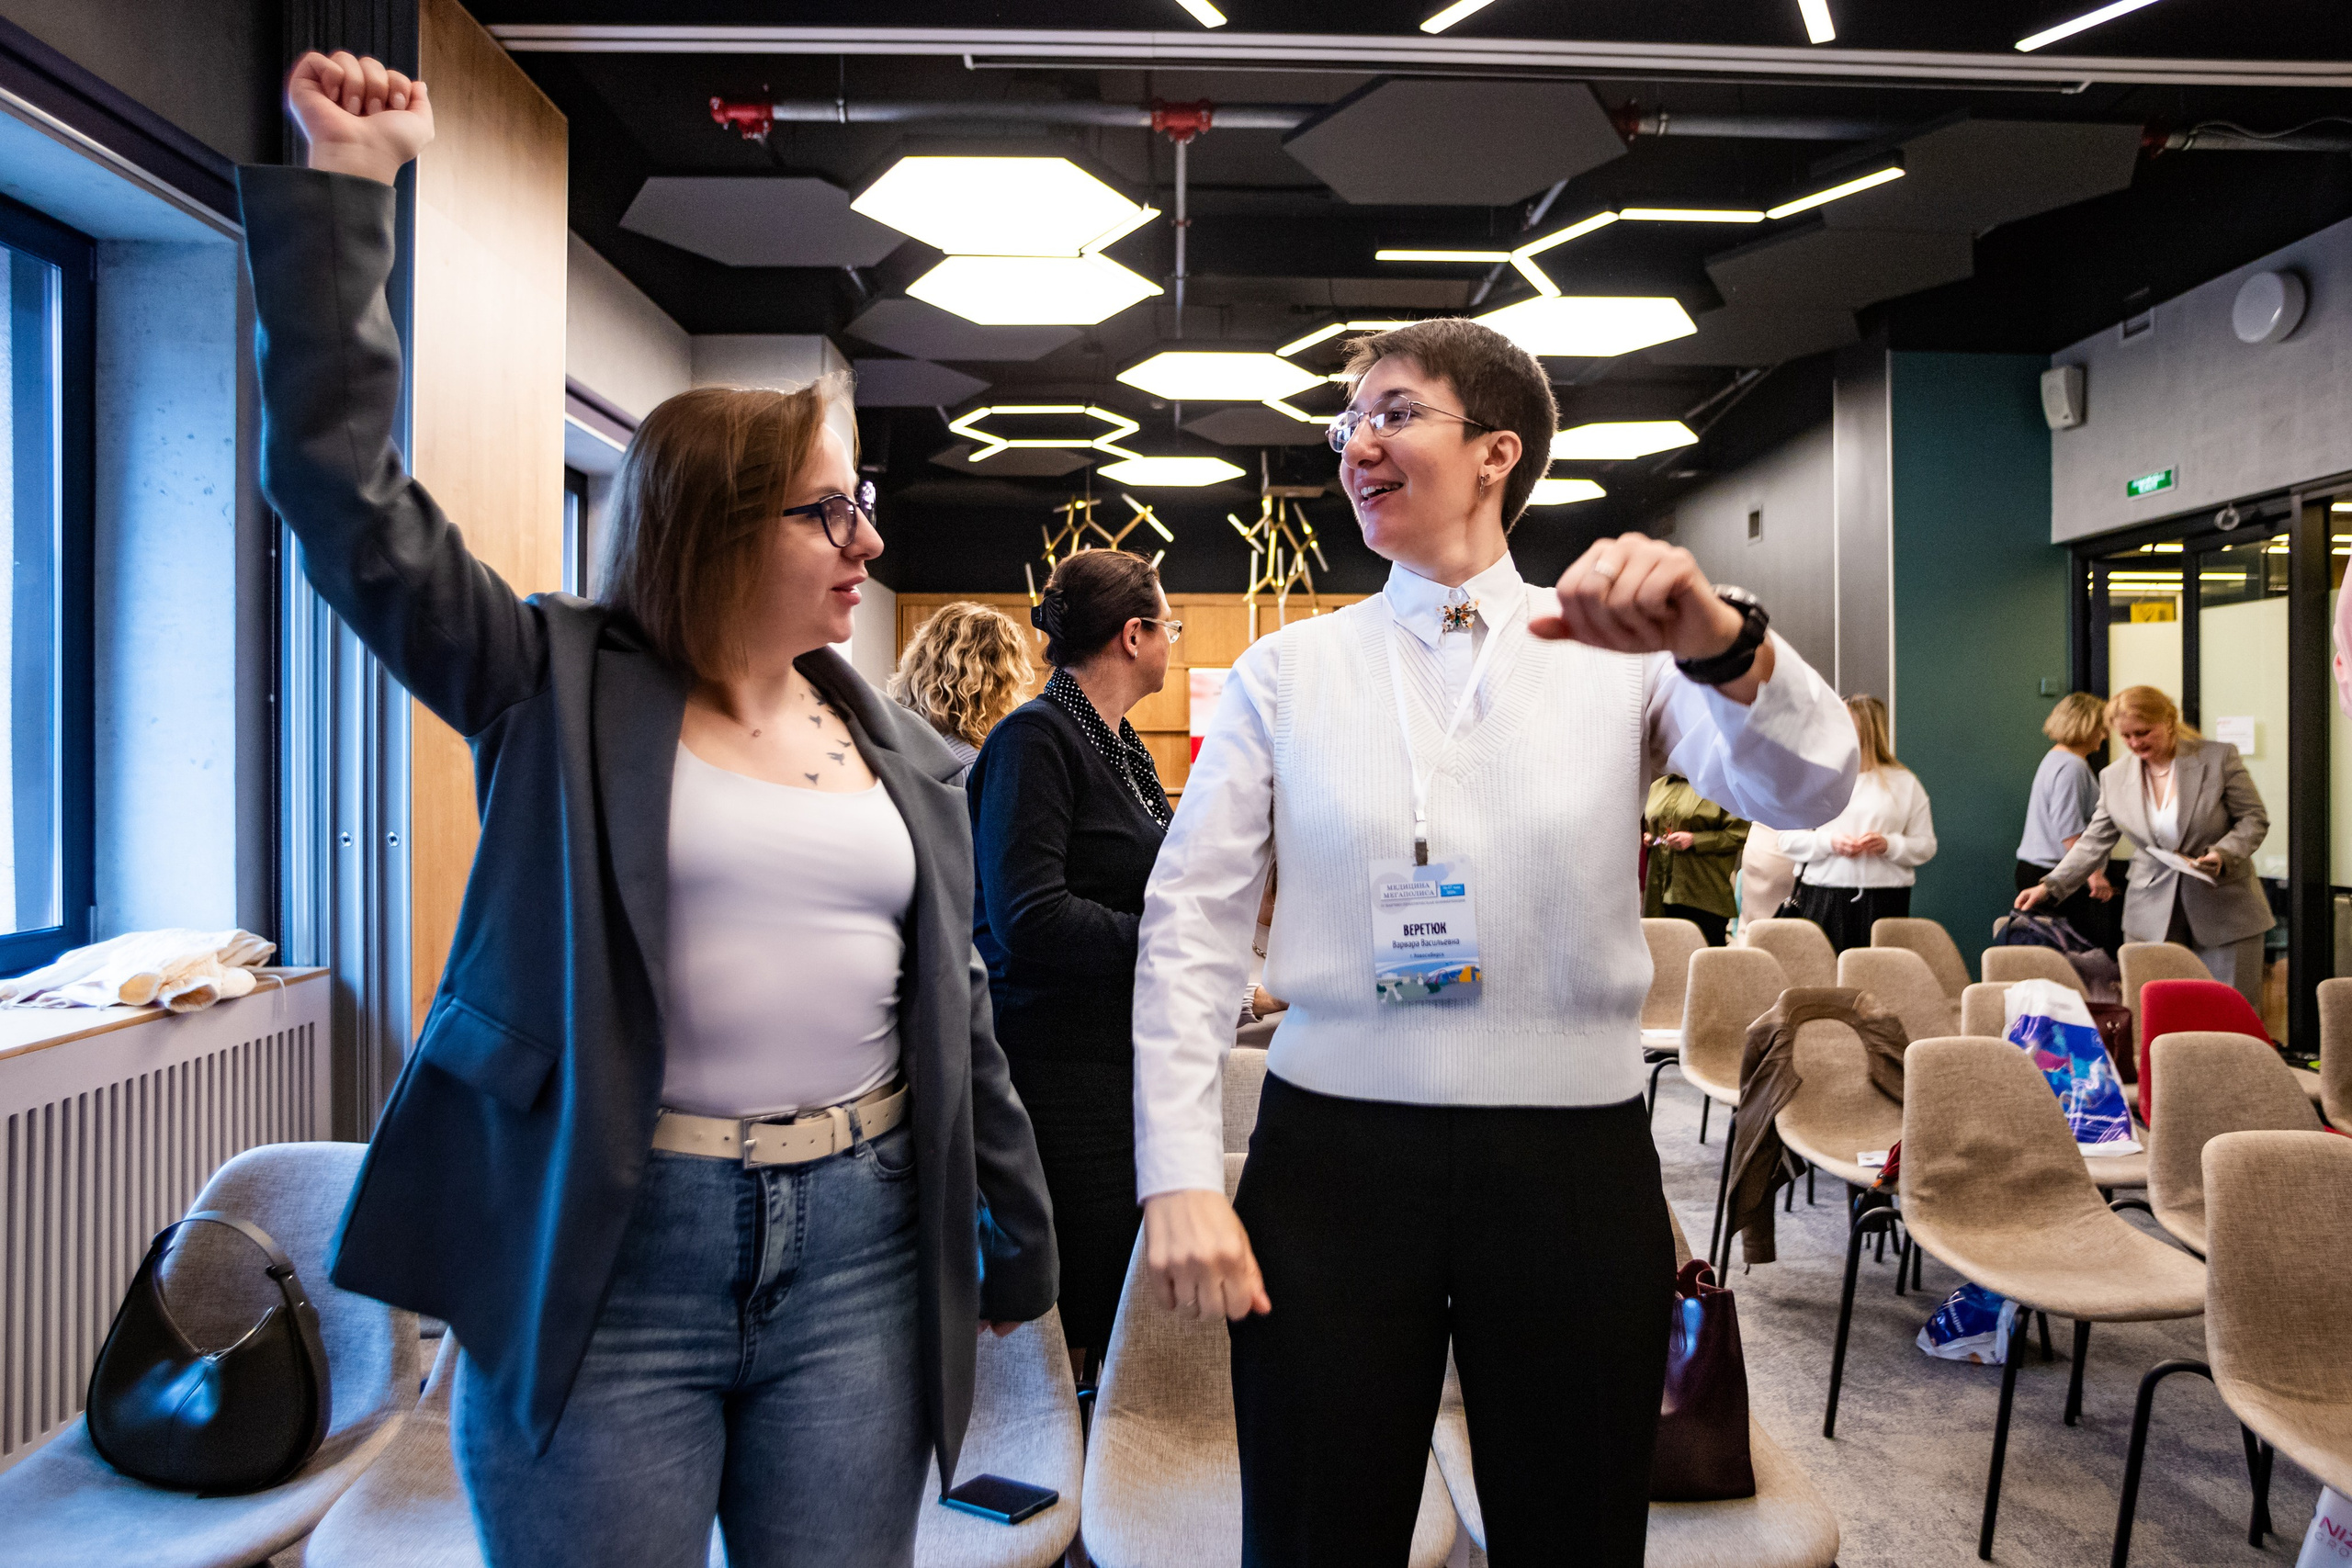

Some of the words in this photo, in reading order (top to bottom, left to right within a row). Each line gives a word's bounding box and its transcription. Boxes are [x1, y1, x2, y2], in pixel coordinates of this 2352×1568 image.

[1386, 883, 1430, 891] МЕДИЦИНА
[1383, 889, 1435, 898] МЕГАПОЛИСА
[1403, 921, 1447, 936] ВЕРЕТЮК
[1392, 940, 1420, 950] Варвара
[1420, 938, 1460, 947] Васильевна
